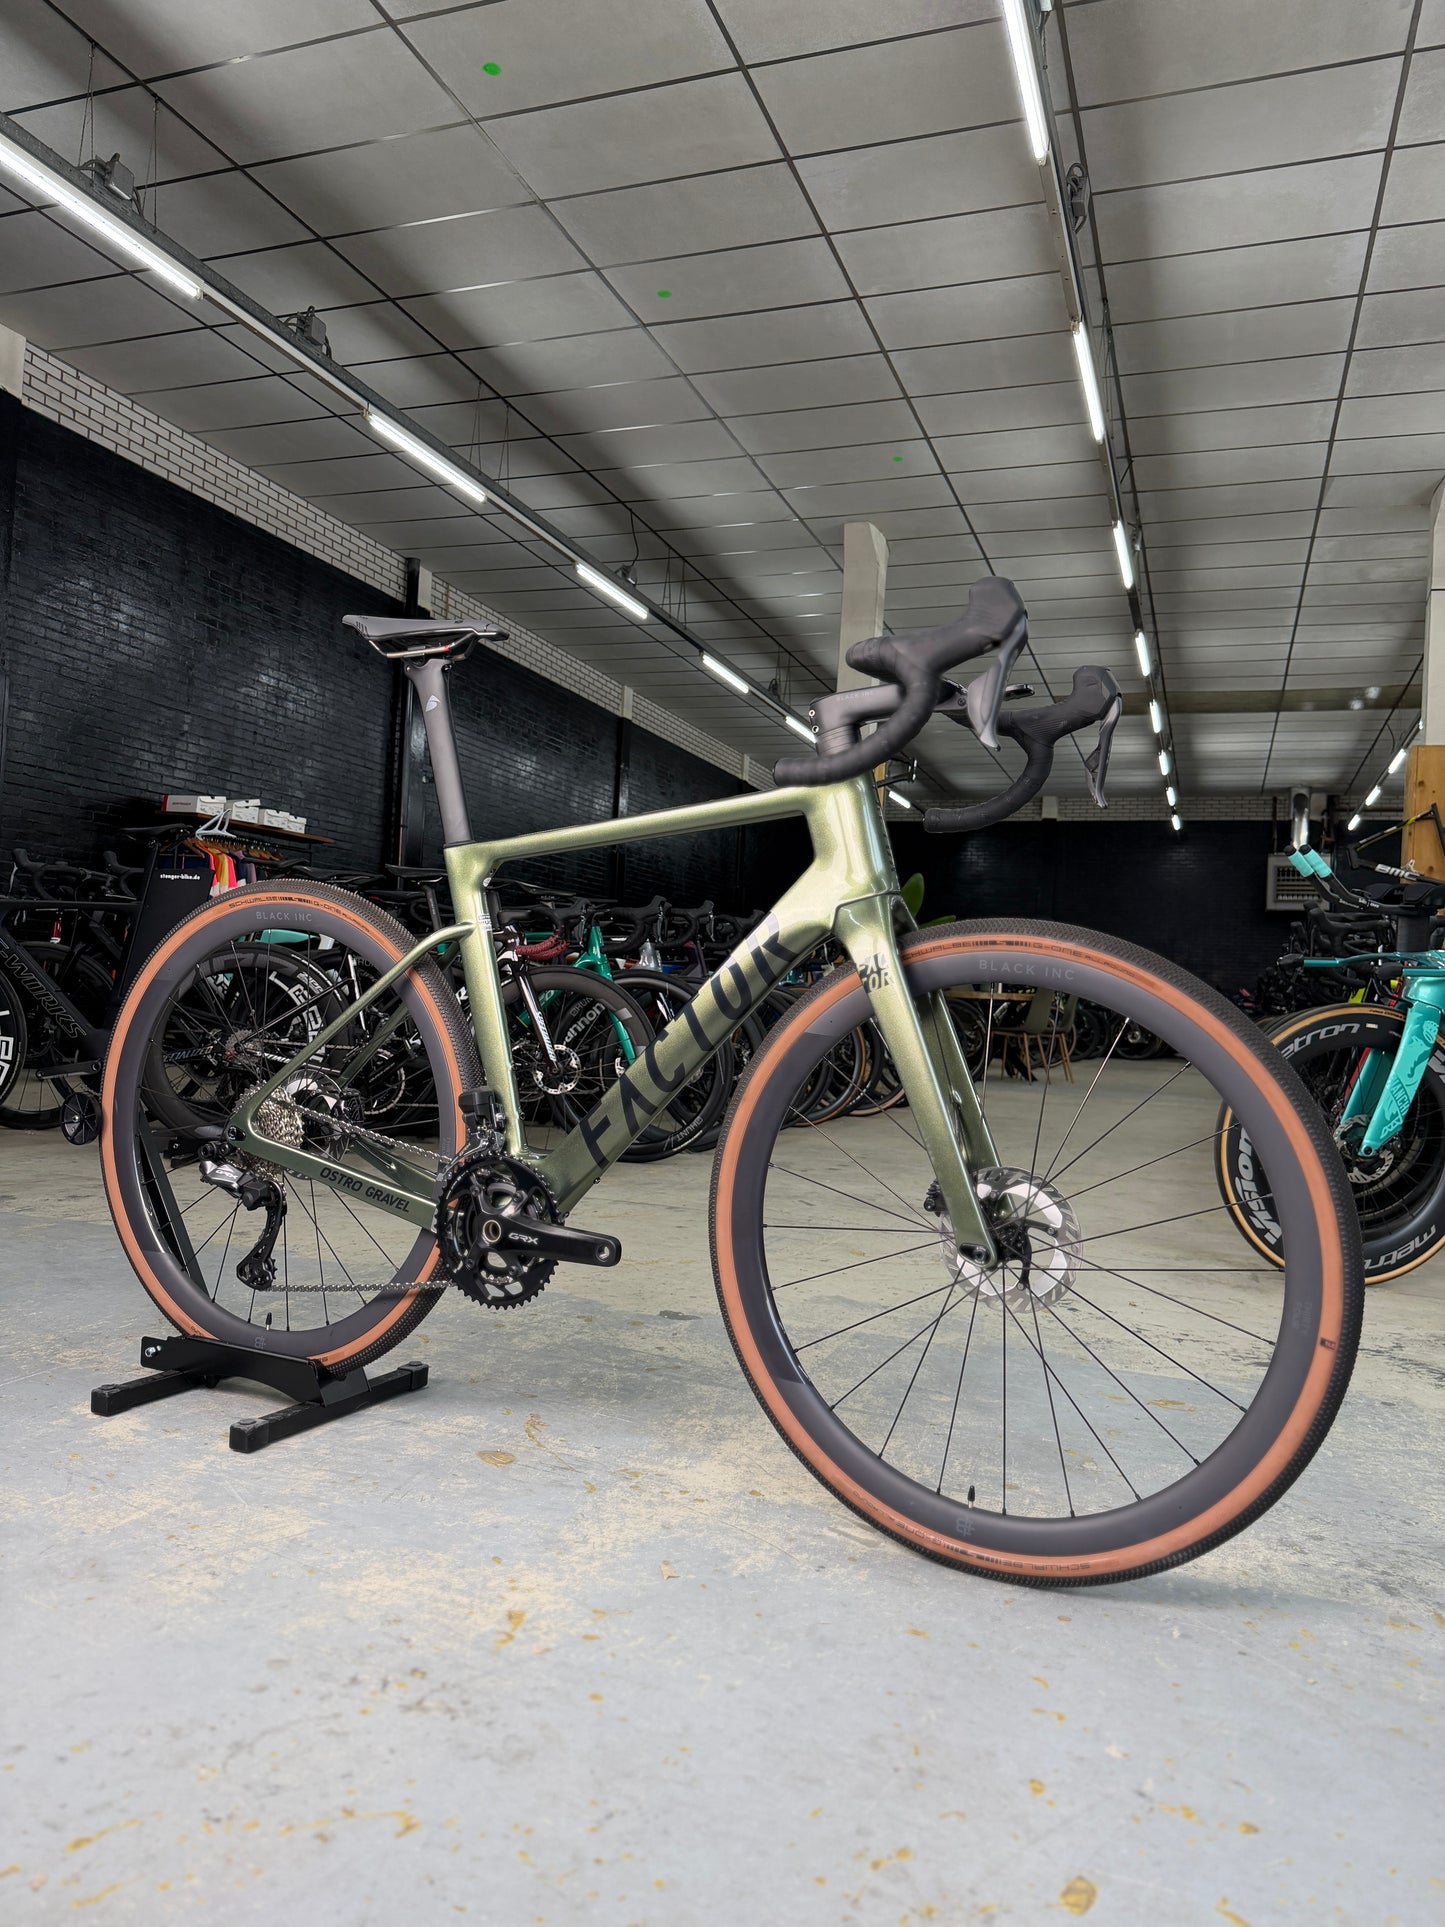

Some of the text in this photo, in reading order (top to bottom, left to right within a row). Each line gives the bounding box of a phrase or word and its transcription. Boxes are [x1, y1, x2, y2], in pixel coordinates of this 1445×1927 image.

[1375, 863, 1421, 881] BMC
[256, 911, 313, 922] BLACK INC
[901, 940, 972, 961] CHWALBE
[979, 959, 1075, 980] BLACK INC
[581, 912, 797, 1168] FACTOR
[1281, 1022, 1361, 1060] etron
[319, 1166, 411, 1214] OSTRO GRAVEL
[508, 1231, 540, 1246] GRX
